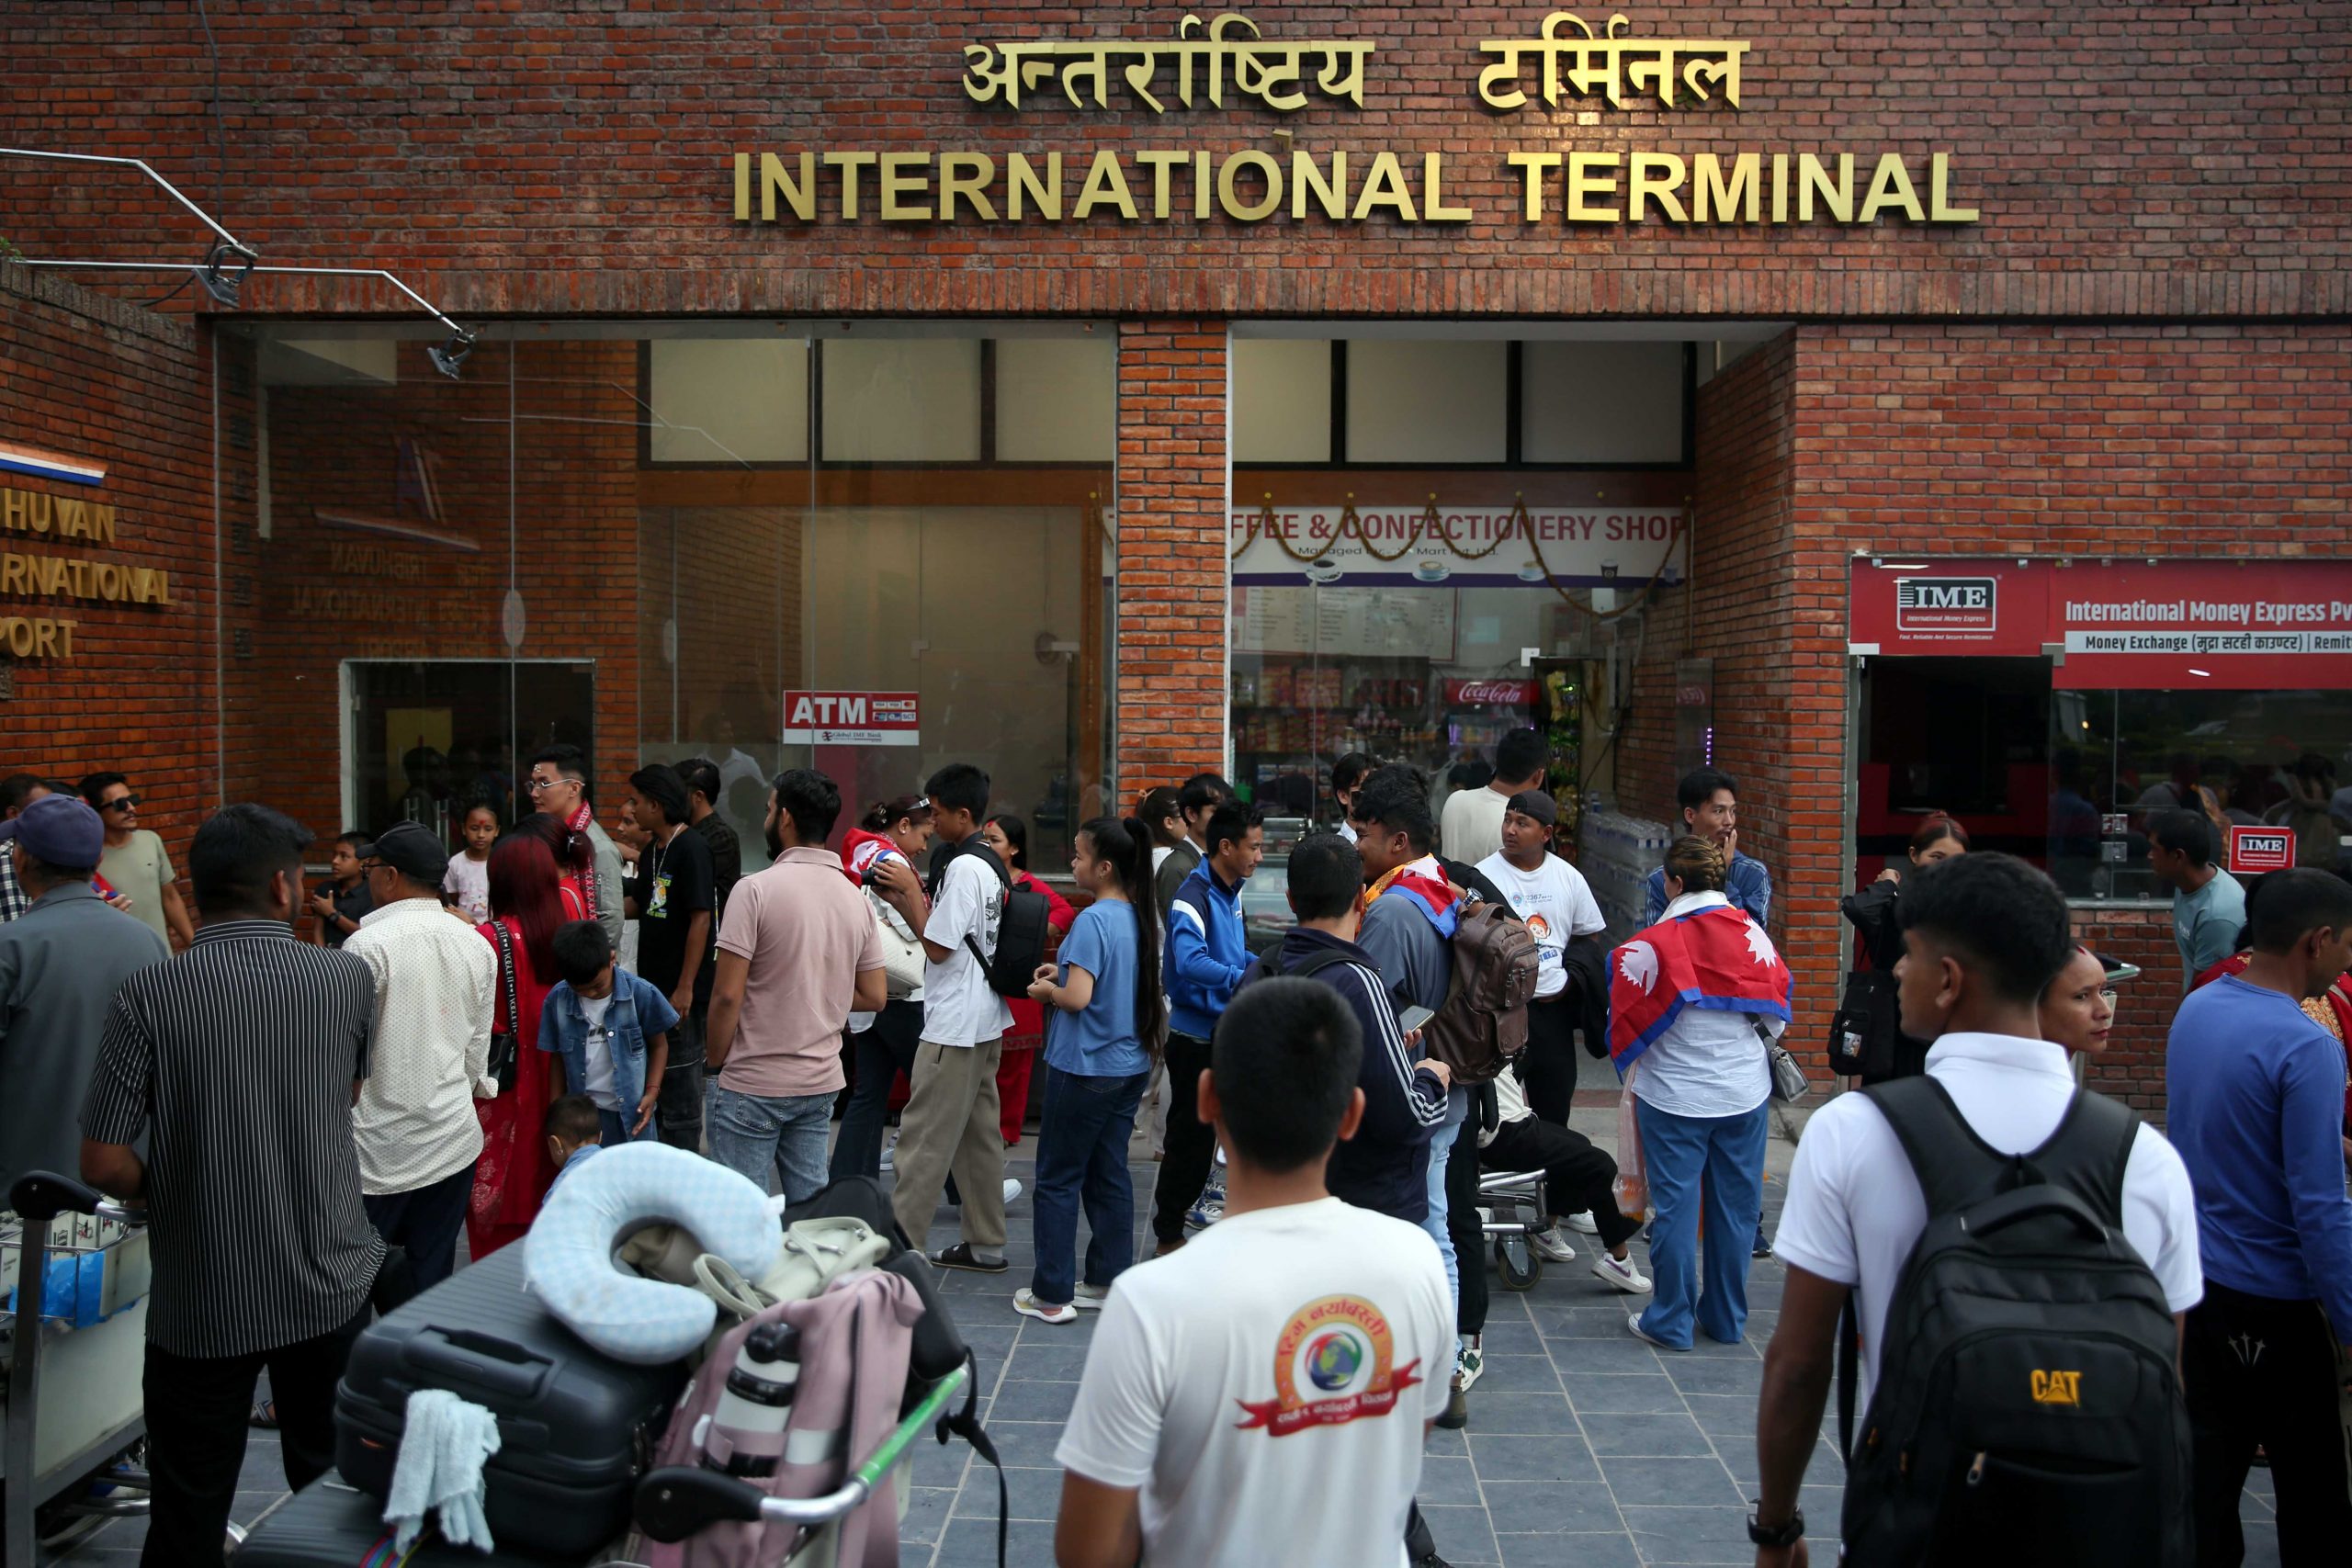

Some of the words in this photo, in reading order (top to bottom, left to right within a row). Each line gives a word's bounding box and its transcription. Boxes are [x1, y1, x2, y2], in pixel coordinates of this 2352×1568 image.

[1477, 11, 1750, 108] टर्मिनल
[734, 150, 1473, 222] INTERNATIONAL
[1507, 152, 1980, 223] TERMINAL
[1308, 513, 1331, 539] &
[1342, 513, 1597, 541] CONFECTIONERY
[1915, 586, 1986, 608] IME
[2065, 600, 2185, 622] International
[2190, 601, 2250, 625] Money
[2255, 602, 2326, 625] Express
[2086, 636, 2125, 651] Money
[2130, 636, 2188, 651] Exchange
[2314, 635, 2352, 649] Remit
[791, 696, 866, 724] ATM
[2247, 839, 2282, 852] IME
[2030, 1370, 2082, 1405] CAT
